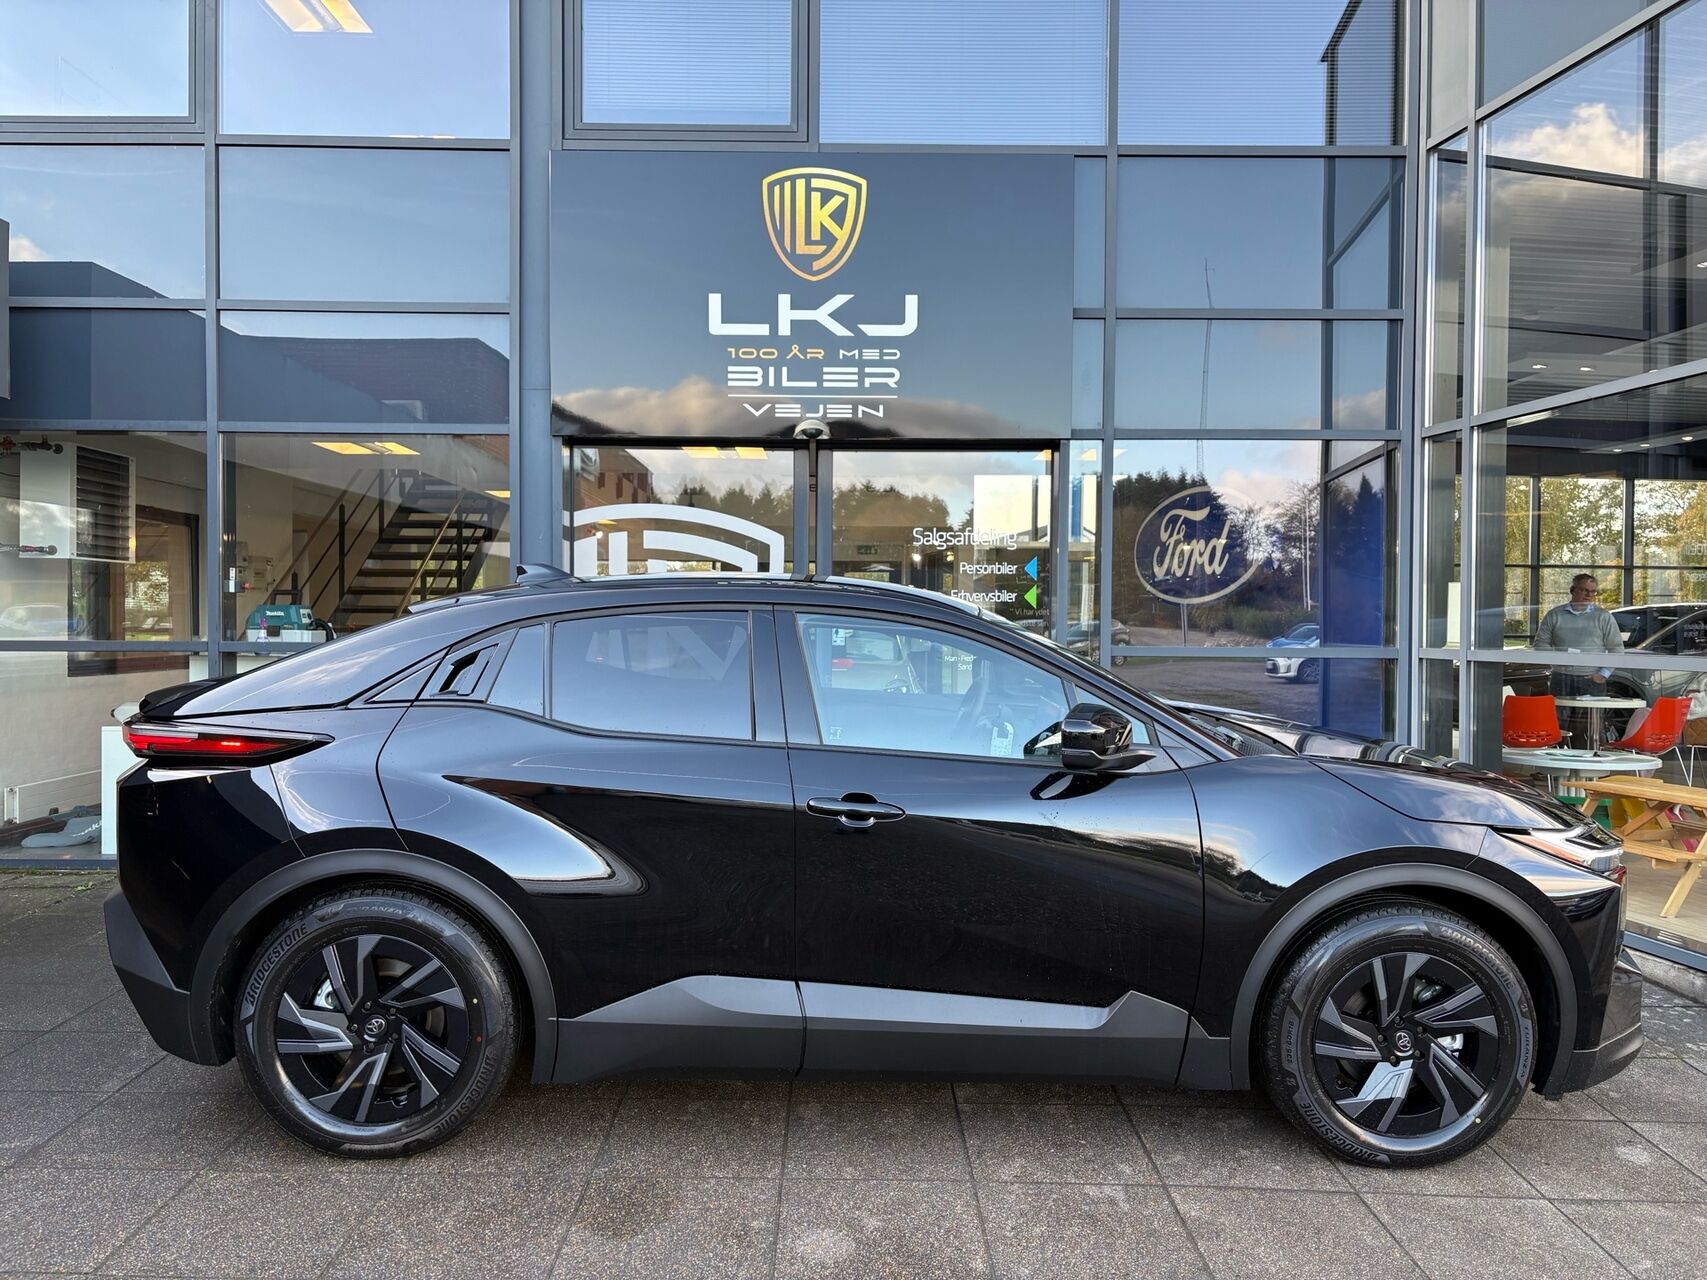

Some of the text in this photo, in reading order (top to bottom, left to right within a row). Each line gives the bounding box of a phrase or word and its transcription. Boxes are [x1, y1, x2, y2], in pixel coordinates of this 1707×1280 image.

[708, 293, 919, 337] LKJ
[727, 344, 901, 360] 100 ÅR MED
[727, 365, 901, 388] BILER
[742, 403, 884, 418] VEJEN
[912, 527, 1018, 551] Salgsafdeling
[1152, 505, 1233, 578] Ford
[959, 561, 1018, 575] Personbiler
[950, 589, 1018, 603] Erhvervsbiler
